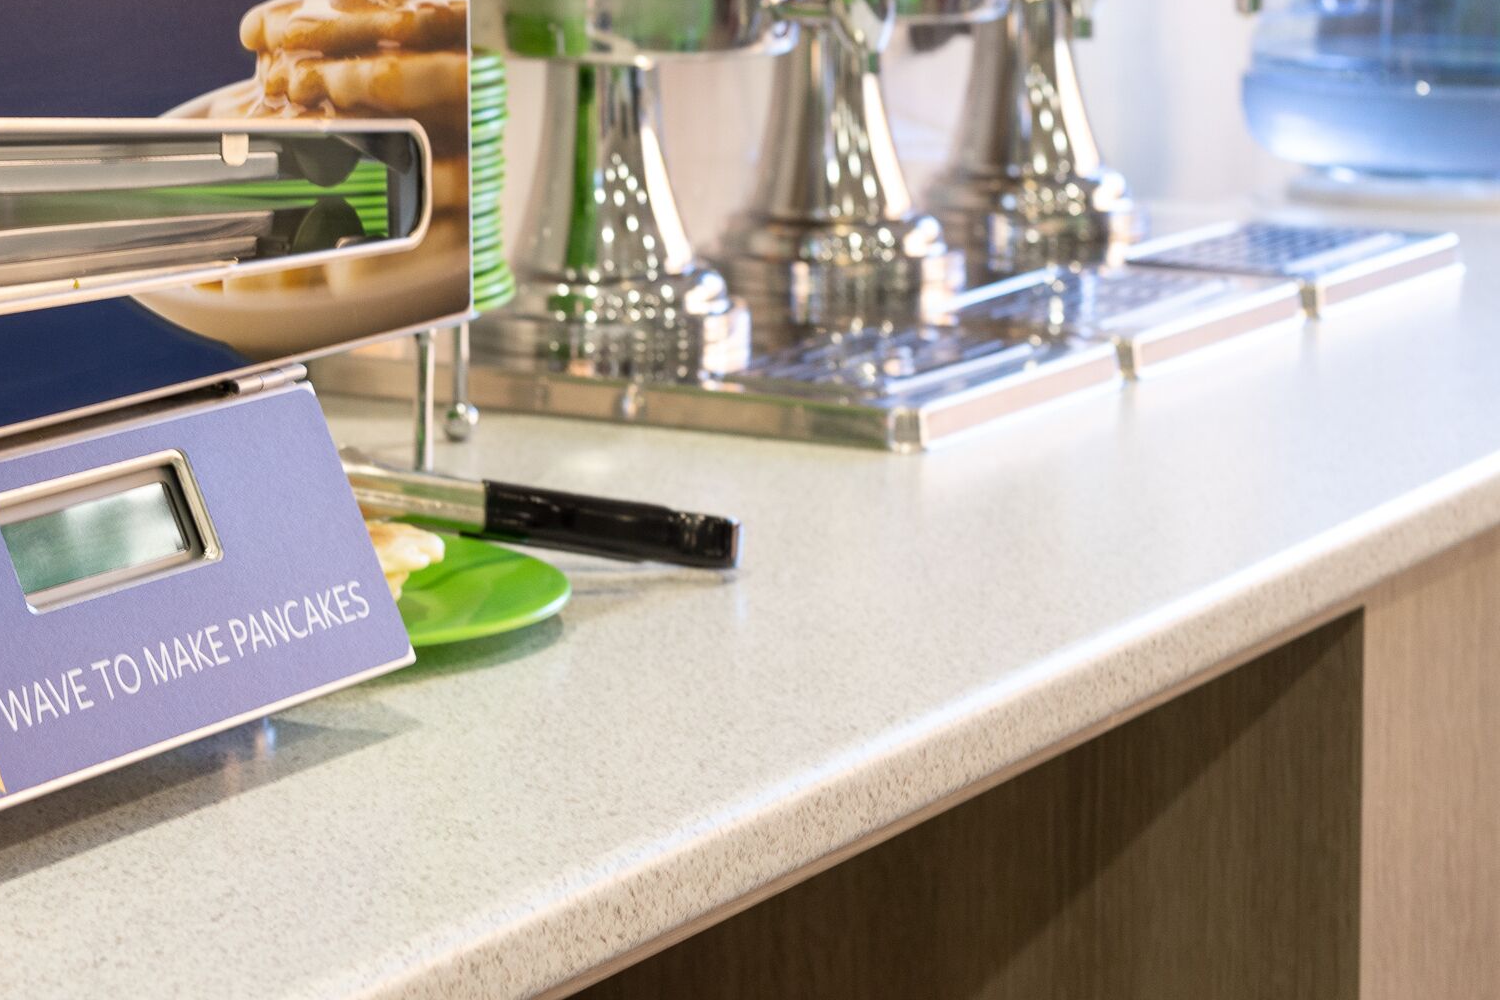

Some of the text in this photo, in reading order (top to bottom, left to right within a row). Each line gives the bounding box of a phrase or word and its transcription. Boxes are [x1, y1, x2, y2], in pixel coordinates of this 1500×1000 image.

[91, 652, 142, 702] TO
[143, 624, 231, 687] MAKE
[231, 580, 371, 659] PANCAKES
